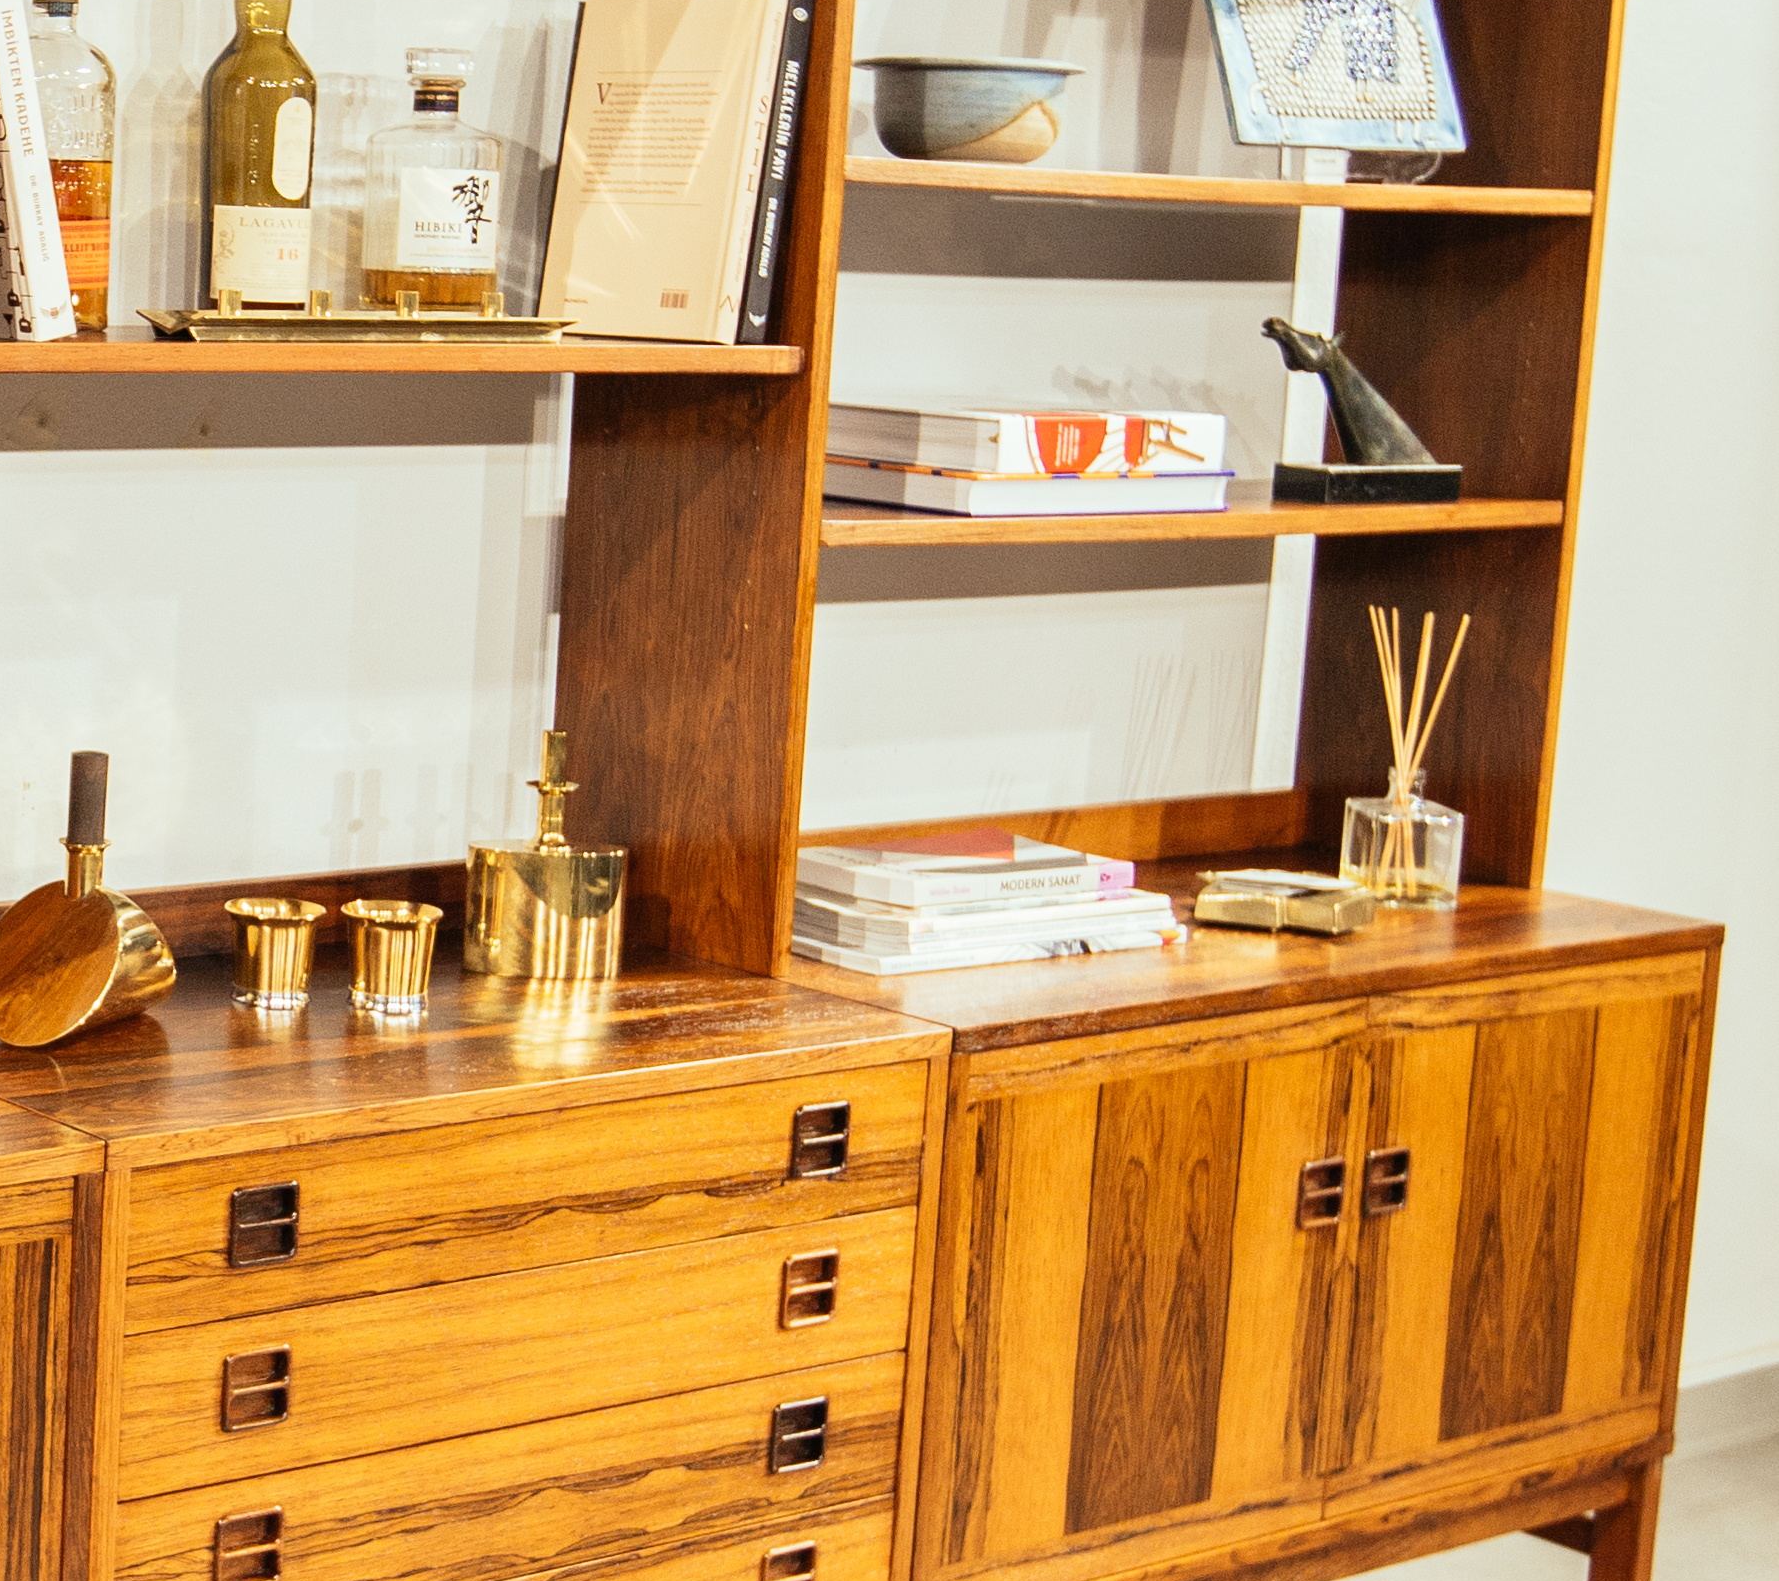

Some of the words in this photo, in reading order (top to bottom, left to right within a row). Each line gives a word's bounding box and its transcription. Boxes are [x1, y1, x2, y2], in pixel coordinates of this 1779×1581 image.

[774, 59, 800, 146] MELEKLERİN
[12, 91, 35, 157] KADEHE
[770, 147, 788, 181] PAYI
[30, 192, 43, 226] BURKAY
[414, 221, 462, 233] HIBIKI
[277, 247, 299, 260] 16
[1000, 876, 1045, 892] MODERN
[1049, 875, 1081, 887] SANAT
